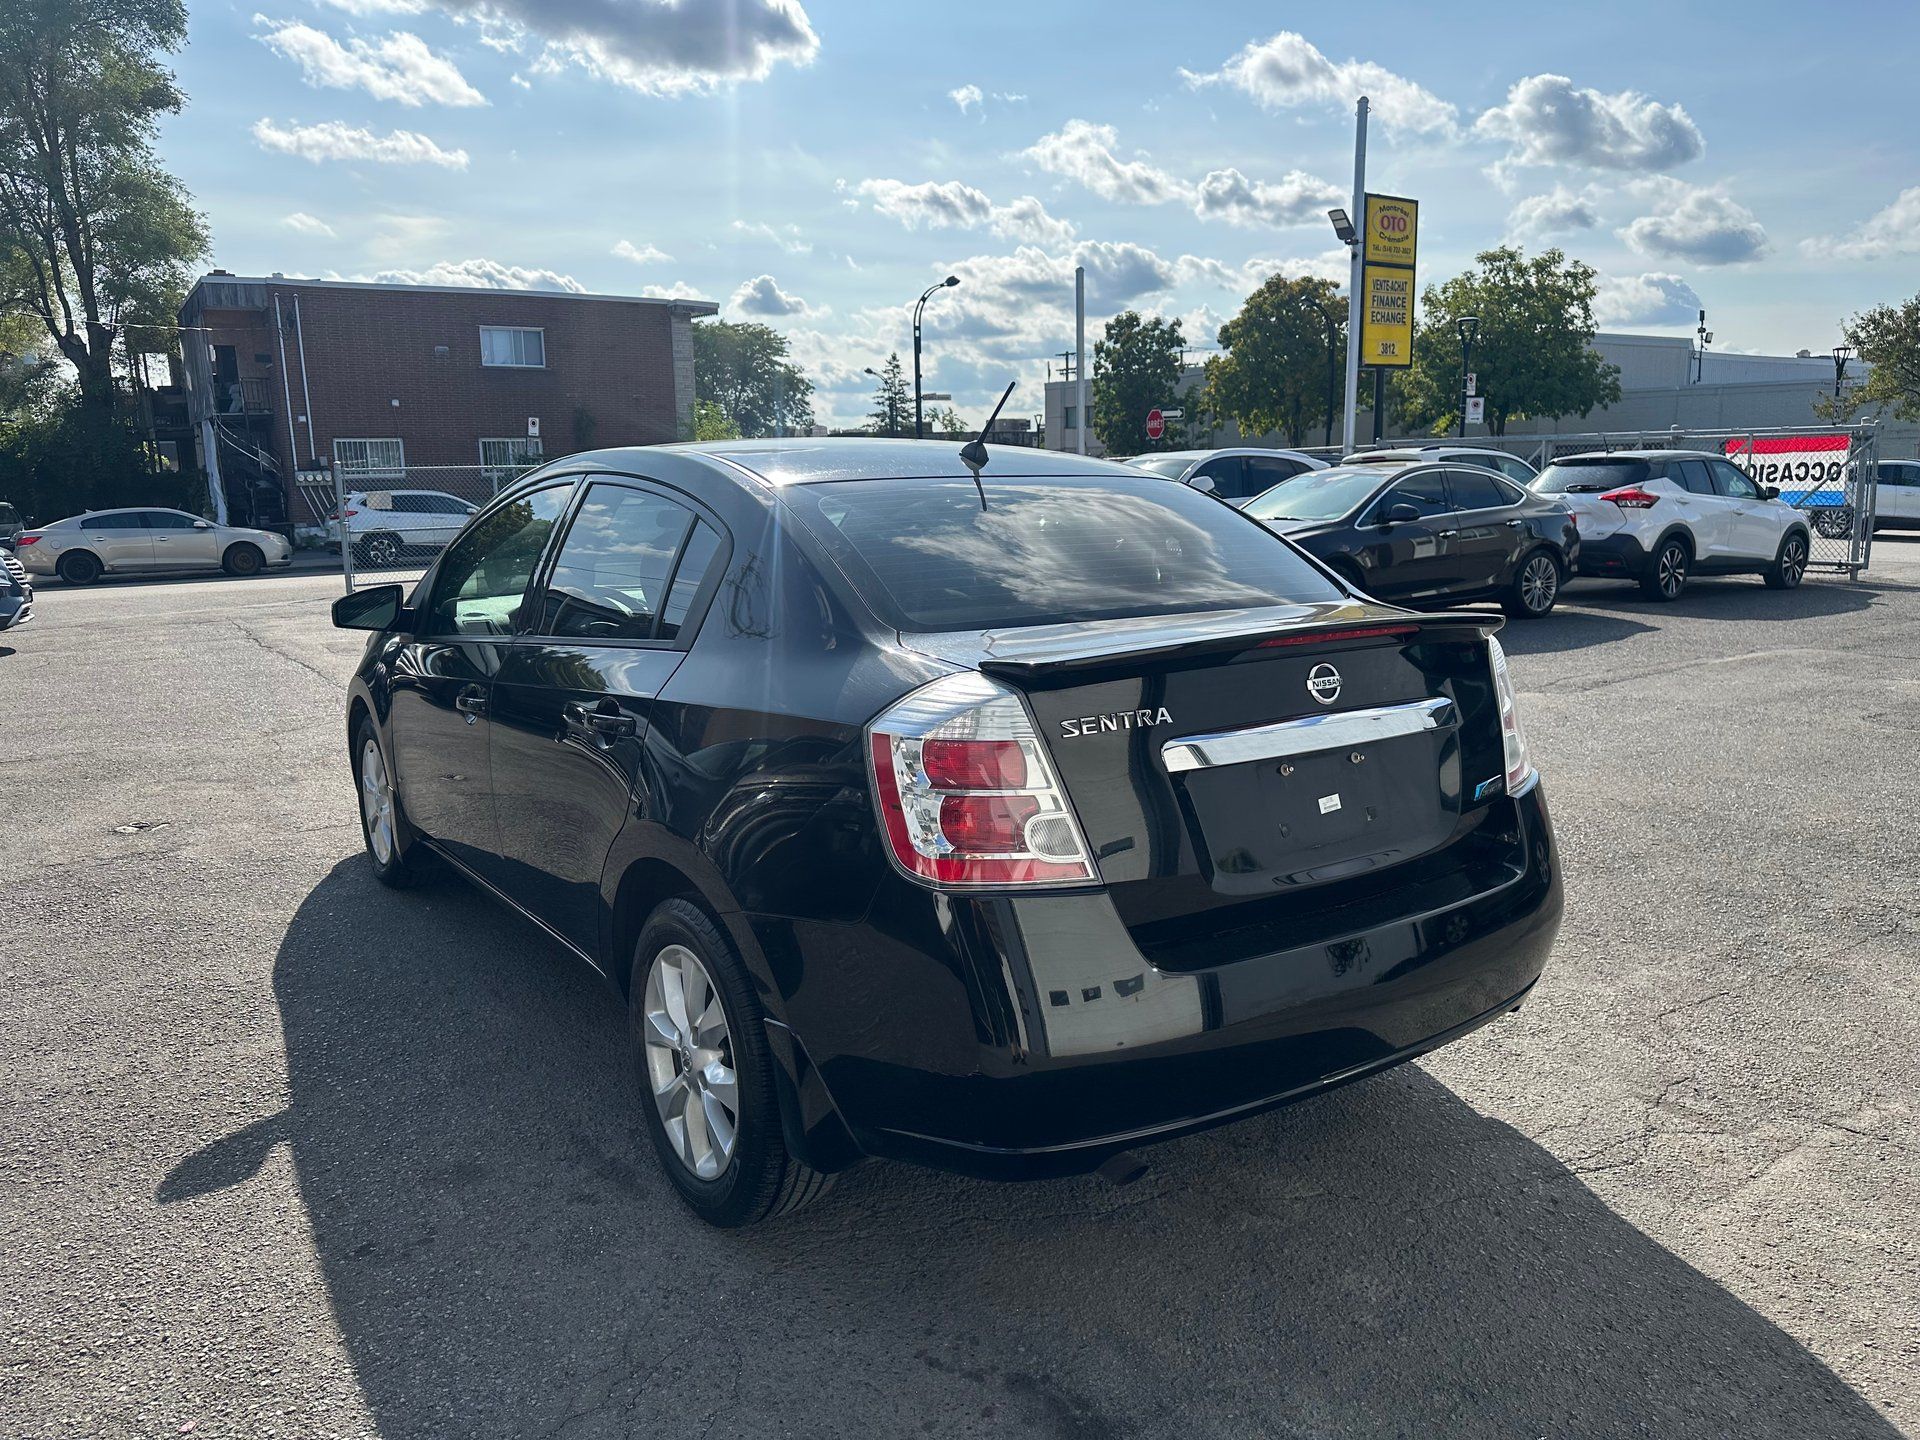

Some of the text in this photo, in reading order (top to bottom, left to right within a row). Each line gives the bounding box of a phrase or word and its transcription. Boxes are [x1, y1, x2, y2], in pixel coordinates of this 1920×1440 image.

[1380, 215, 1407, 232] OTO
[1372, 295, 1406, 308] FINANCE
[1371, 311, 1406, 324] ECHANGE
[1381, 342, 1396, 355] 3812
[1312, 677, 1341, 688] NISSAN
[1060, 706, 1174, 739] SENTRA
